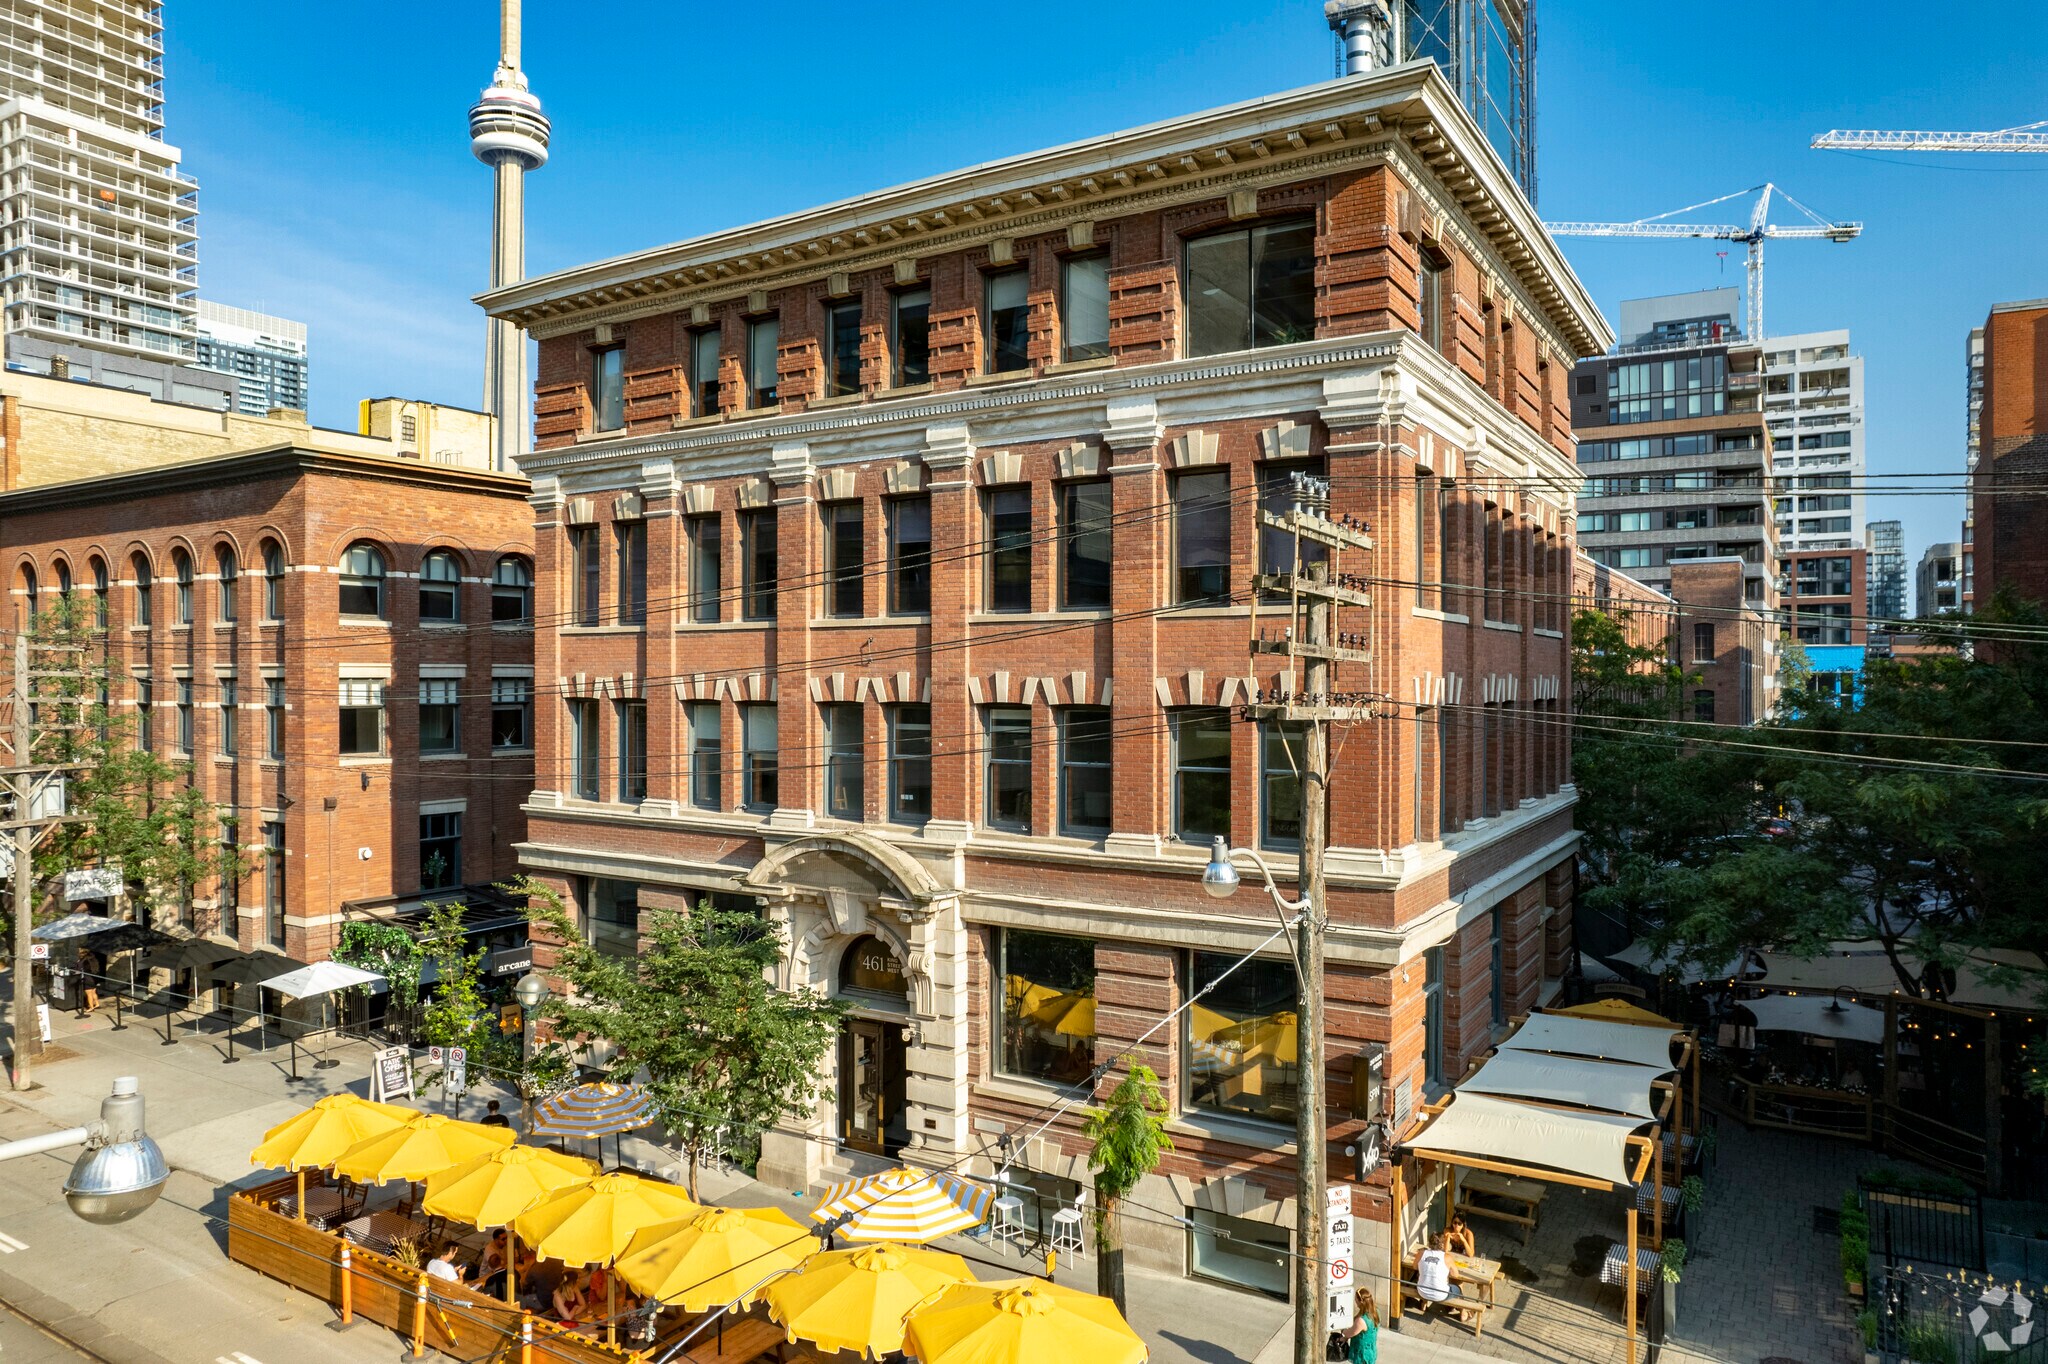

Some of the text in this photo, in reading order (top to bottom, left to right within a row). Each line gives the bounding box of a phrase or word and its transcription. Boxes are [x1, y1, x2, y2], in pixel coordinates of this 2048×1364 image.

[498, 959, 531, 972] arcane
[863, 955, 885, 971] 461
[1335, 1189, 1343, 1197] NO
[1334, 1222, 1347, 1231] TAXI
[1330, 1235, 1351, 1247] 5 TAXIS
